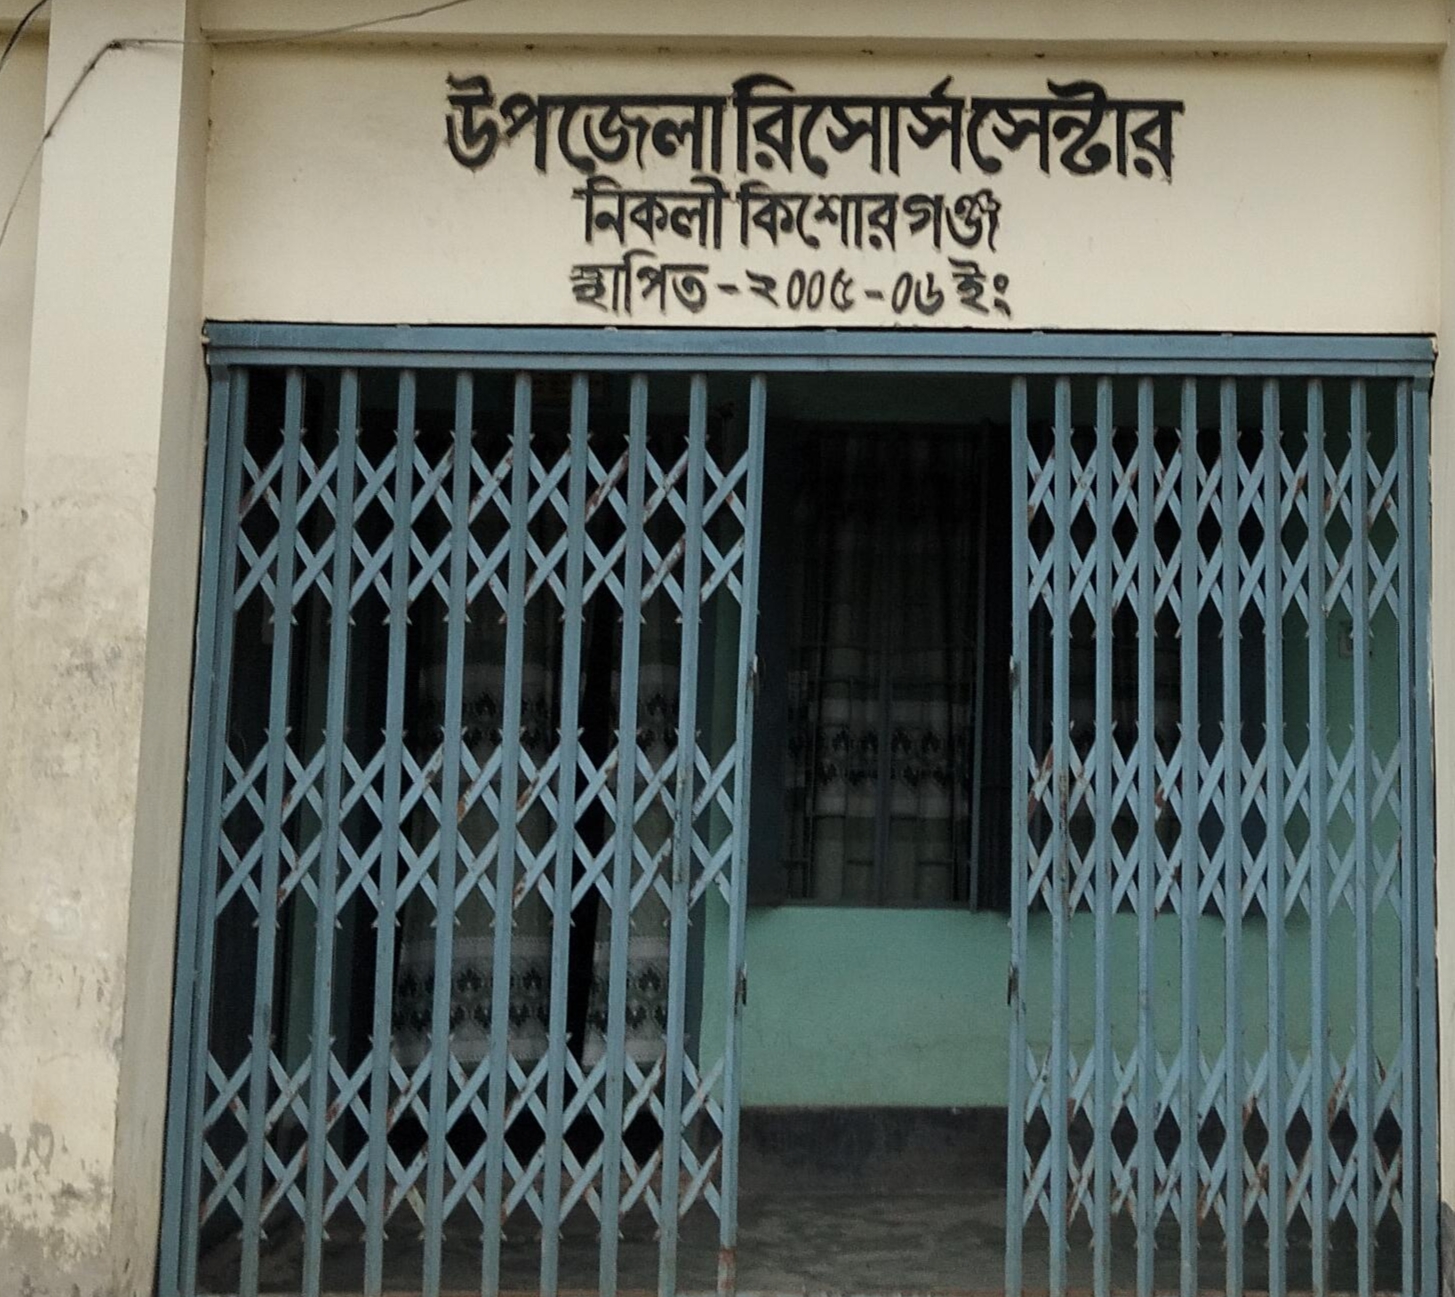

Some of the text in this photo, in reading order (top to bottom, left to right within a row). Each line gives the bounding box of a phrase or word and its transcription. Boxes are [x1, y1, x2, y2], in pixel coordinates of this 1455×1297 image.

[447, 72, 1184, 184] উপজেলা রিসোর্স সেন্টার
[572, 175, 729, 250] নিকলী
